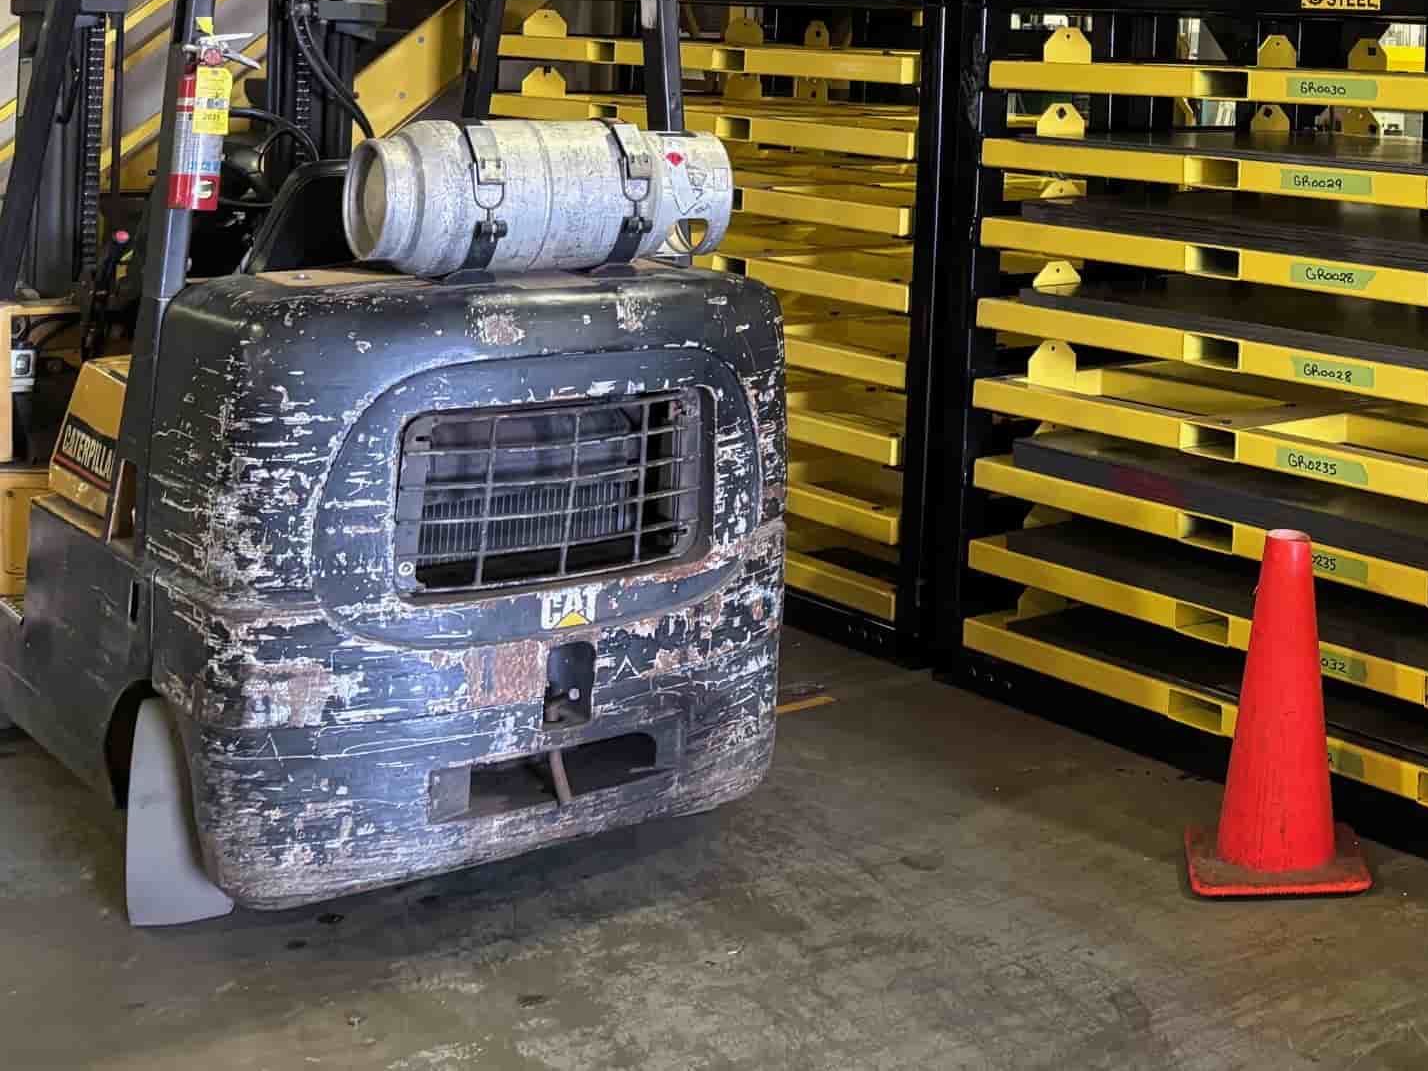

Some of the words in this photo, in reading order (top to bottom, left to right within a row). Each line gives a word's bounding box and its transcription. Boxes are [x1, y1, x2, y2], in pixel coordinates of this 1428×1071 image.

[1299, 81, 1346, 95] GR0030
[62, 424, 114, 482] CATERPILLA
[540, 582, 603, 630] CAT
